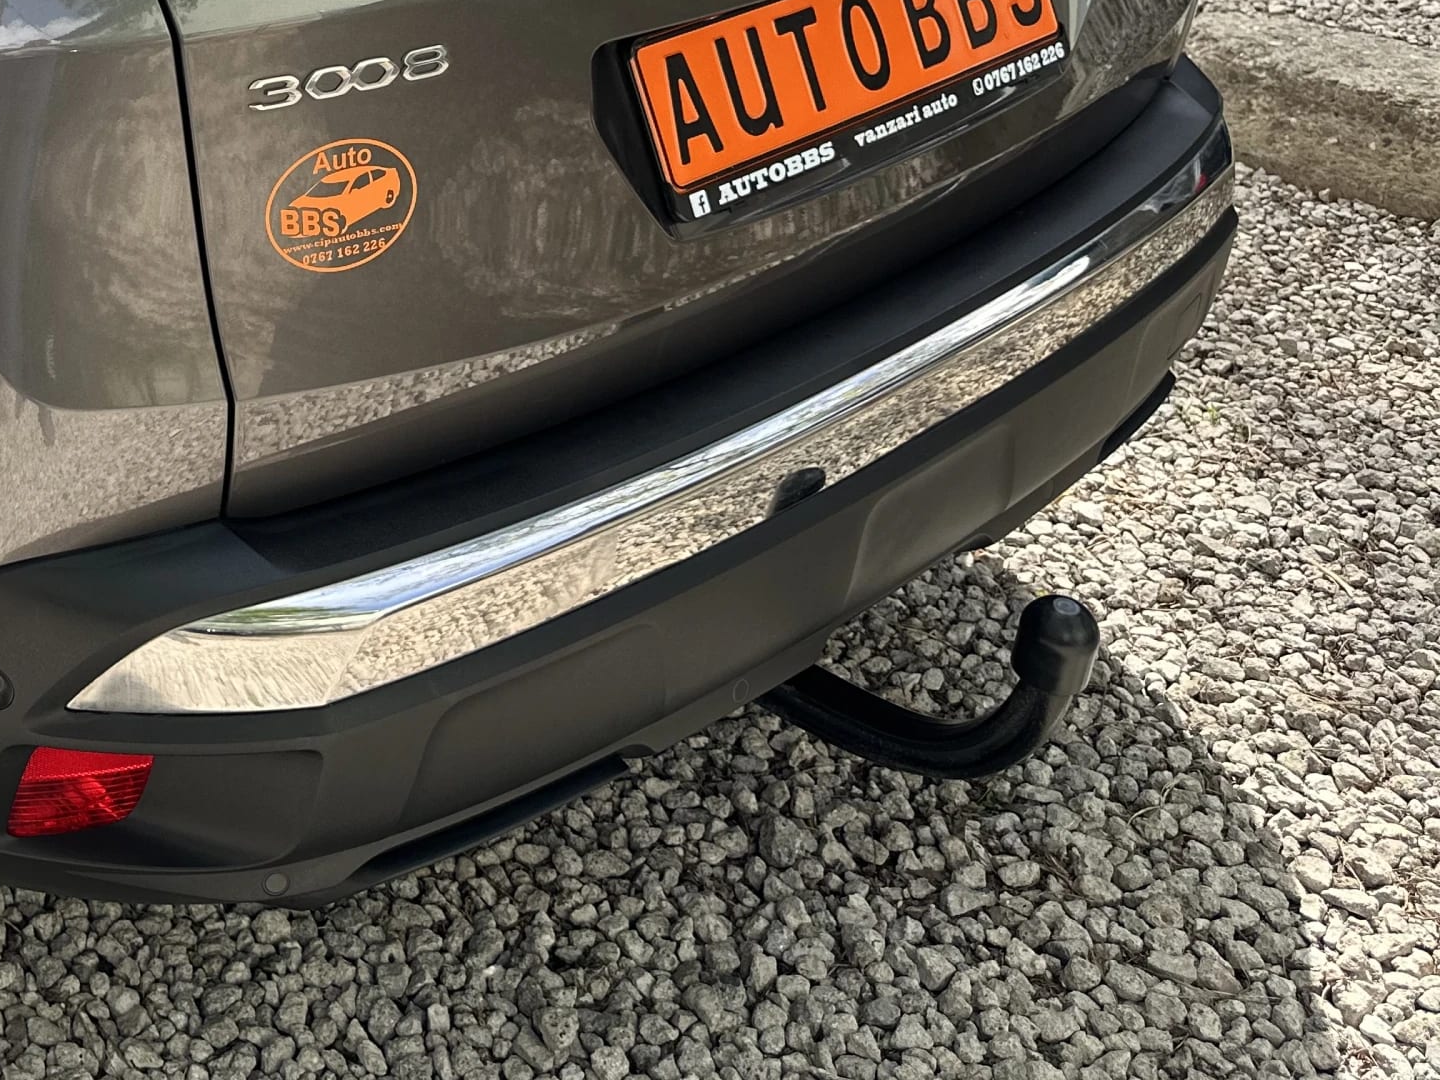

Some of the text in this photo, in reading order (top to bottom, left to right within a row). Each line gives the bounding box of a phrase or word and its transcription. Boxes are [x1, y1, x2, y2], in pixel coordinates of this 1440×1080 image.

[248, 44, 450, 111] 3008
[718, 141, 836, 206] AUTOBBS
[854, 104, 922, 147] vanzari
[922, 93, 958, 119] auto
[1040, 42, 1065, 65] 226
[312, 146, 372, 175] Auto
[280, 209, 340, 237] BBS
[302, 237, 386, 266] 0767 162 226
